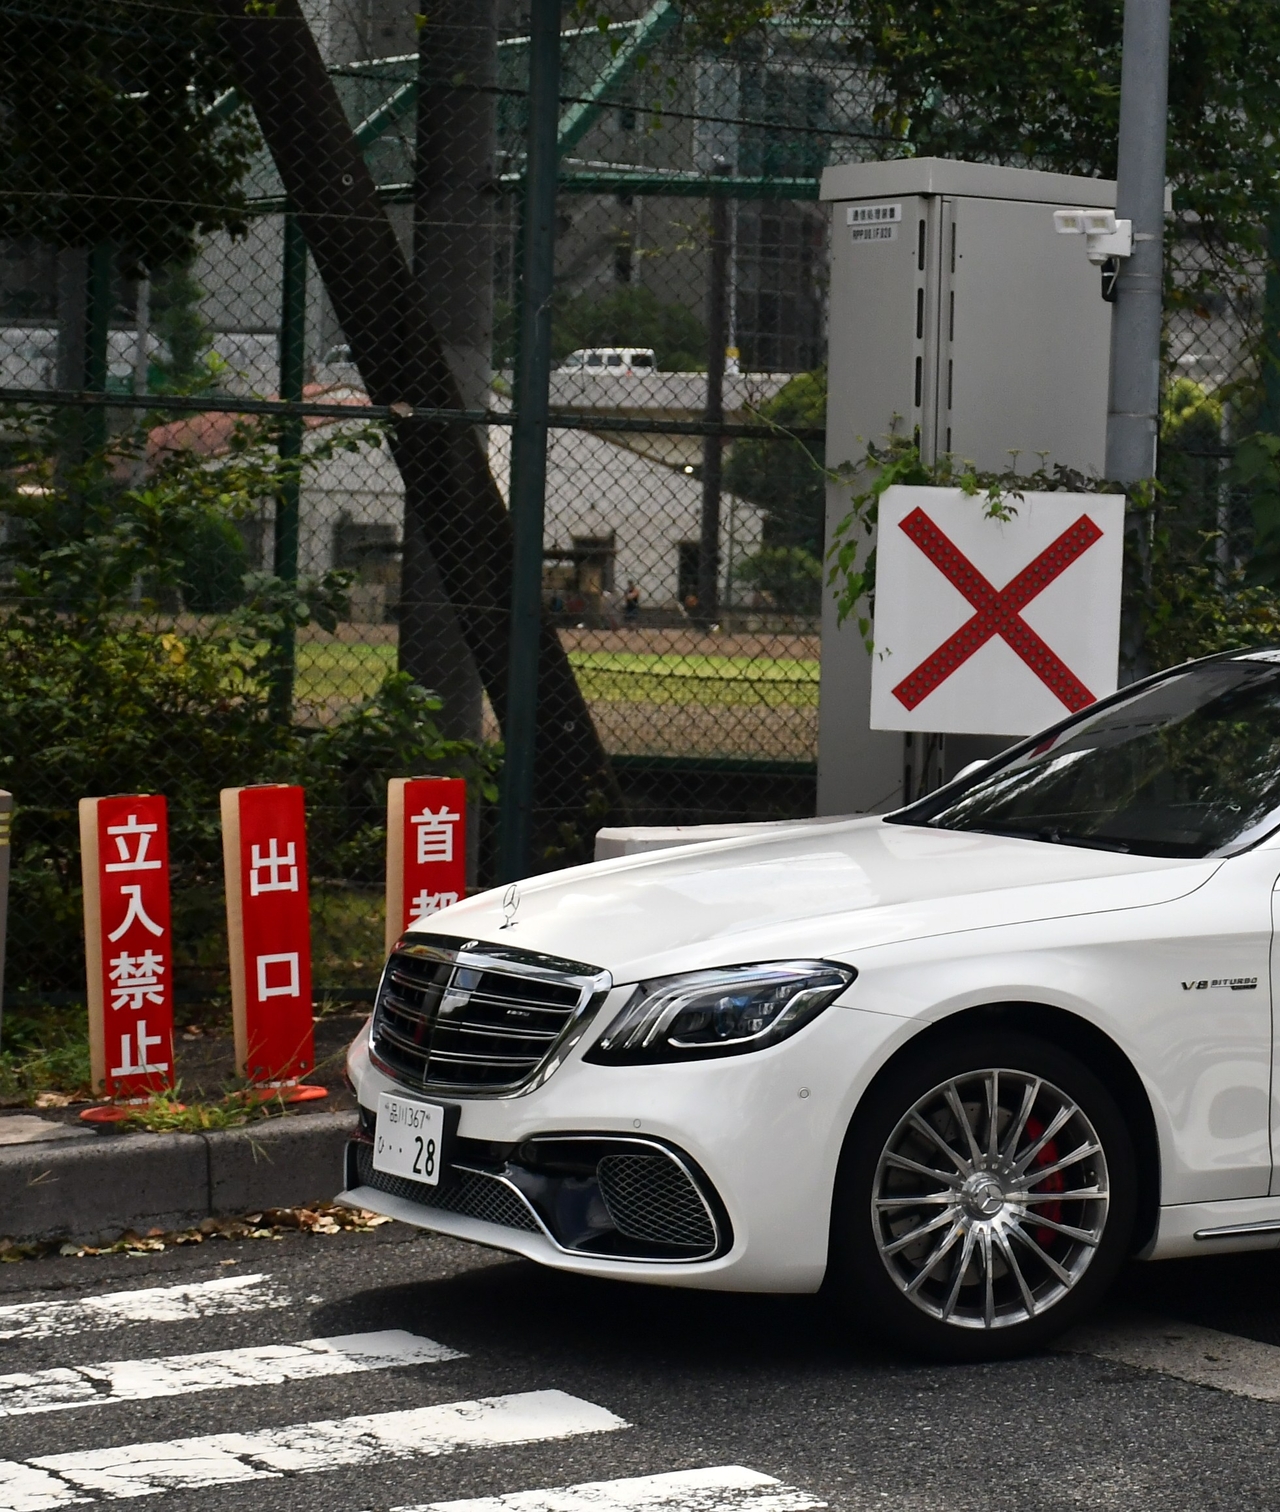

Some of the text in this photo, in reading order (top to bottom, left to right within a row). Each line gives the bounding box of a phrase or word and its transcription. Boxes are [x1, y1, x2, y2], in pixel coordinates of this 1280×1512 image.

[105, 814, 168, 1077] 立入禁止
[250, 838, 300, 1002] 出口
[1181, 977, 1257, 990] V8 BITURBO
